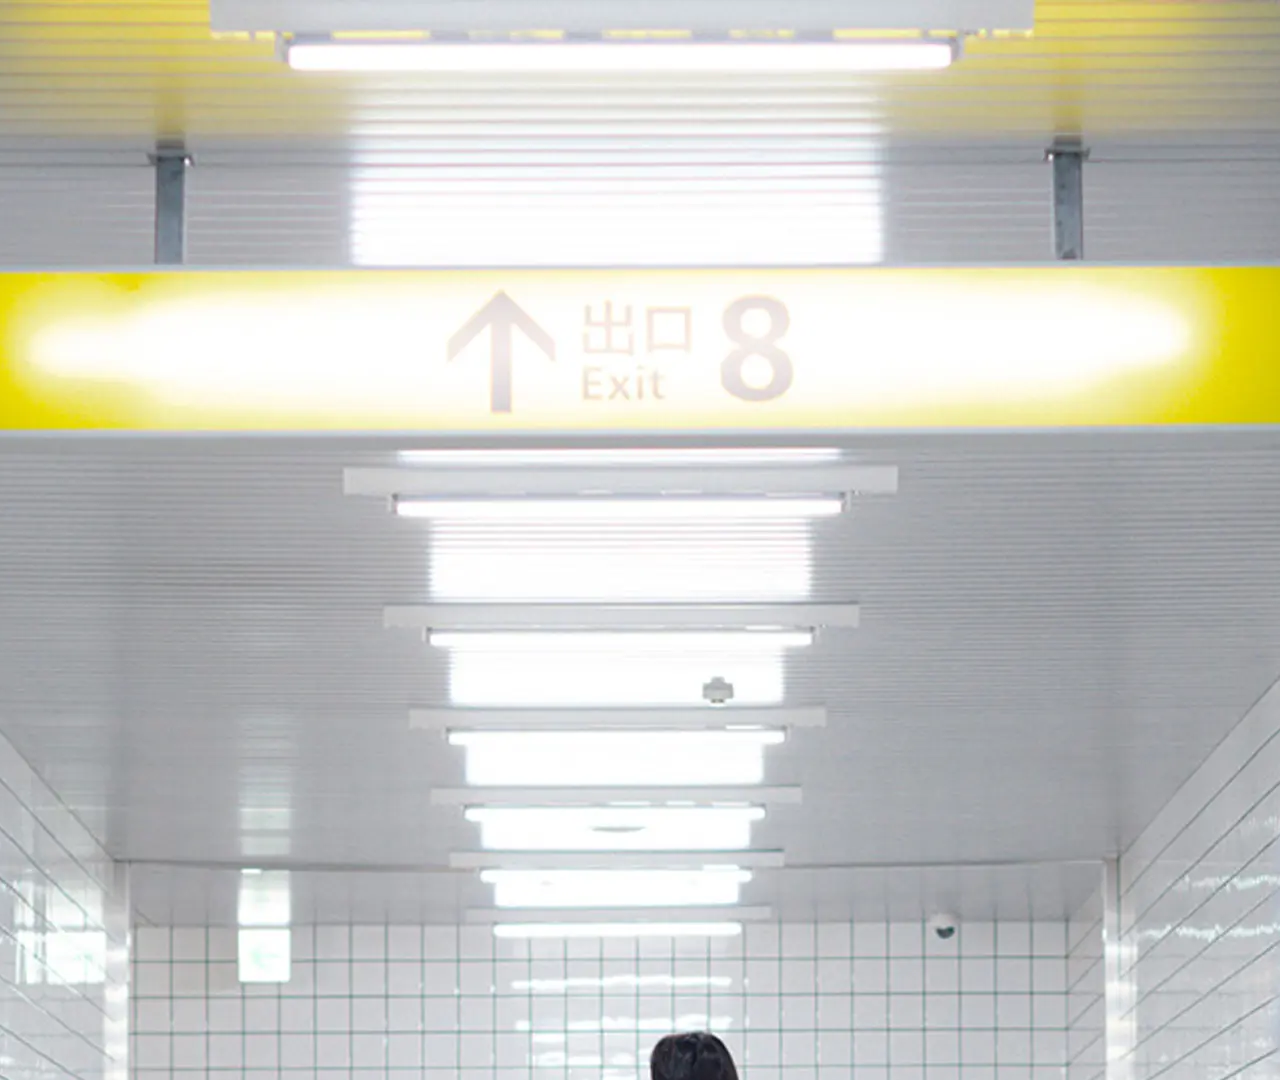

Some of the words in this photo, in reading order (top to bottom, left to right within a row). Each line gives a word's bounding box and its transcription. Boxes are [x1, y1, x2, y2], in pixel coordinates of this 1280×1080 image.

[584, 300, 692, 355] 出口
[721, 295, 793, 402] 8
[583, 366, 665, 400] Exit
